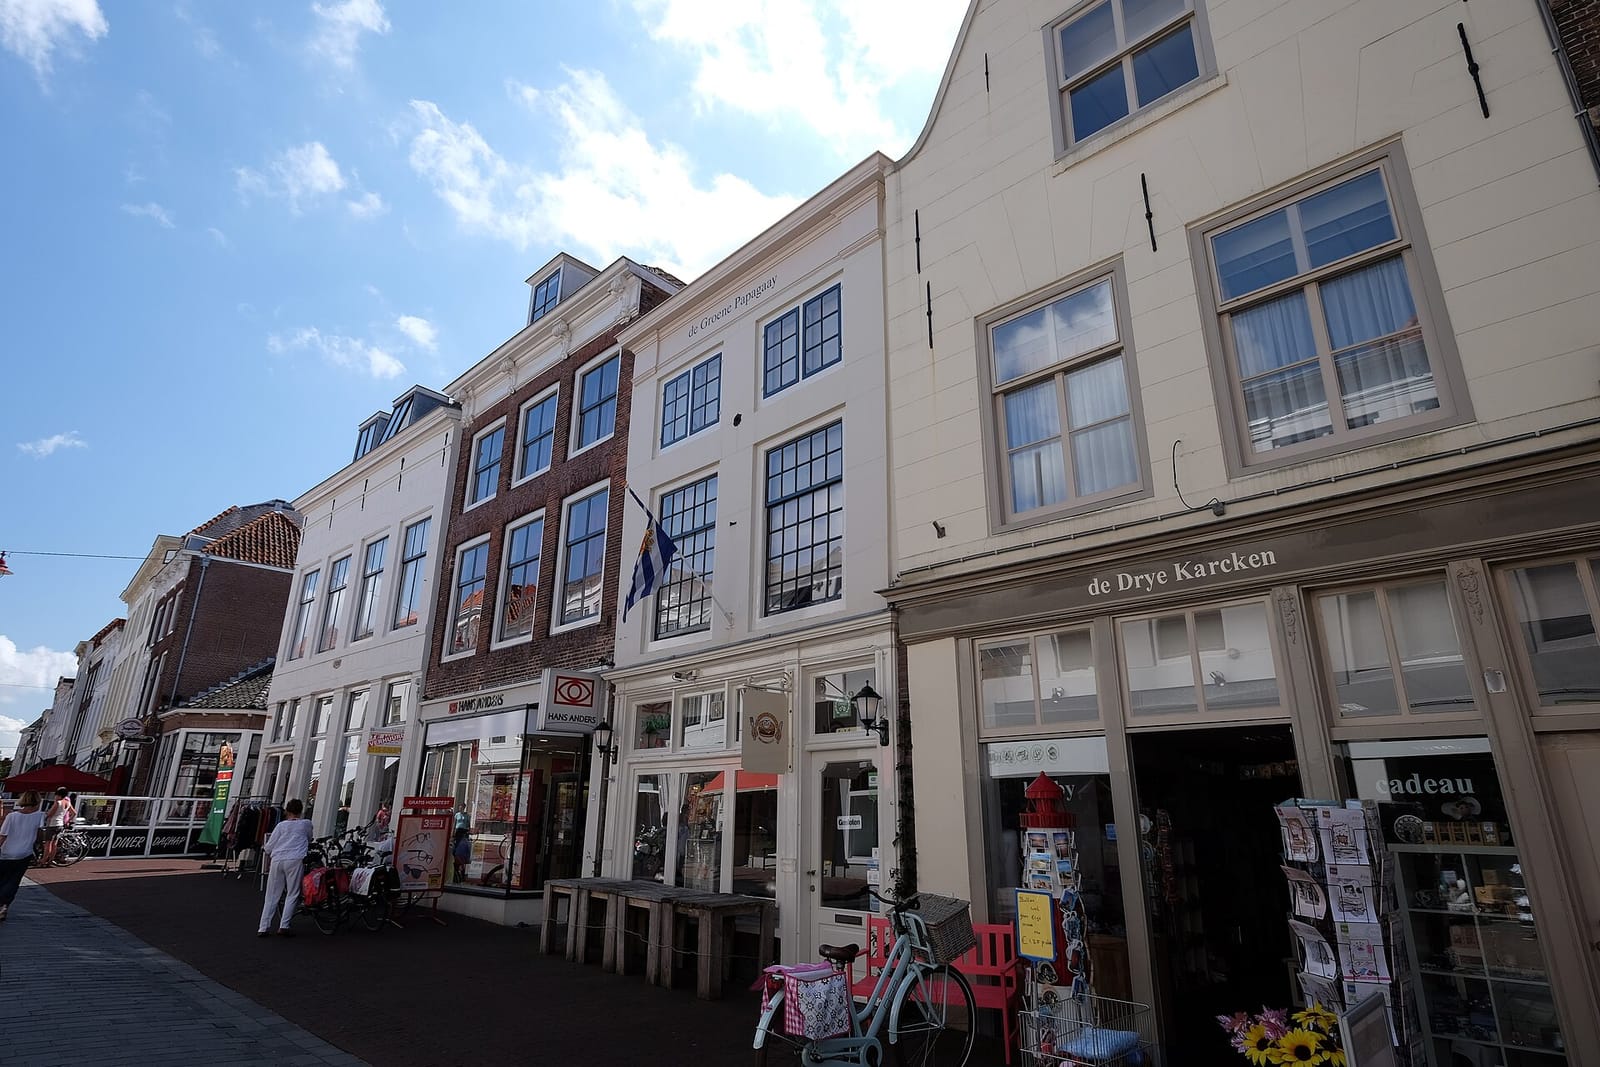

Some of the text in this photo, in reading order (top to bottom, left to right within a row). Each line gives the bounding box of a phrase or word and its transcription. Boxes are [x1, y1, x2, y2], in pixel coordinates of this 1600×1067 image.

[688, 275, 778, 338] de Groene Papagaay
[1087, 549, 1277, 596] de Drye Karcken
[547, 712, 597, 724] HANS ANDERS
[1375, 772, 1476, 795] cadeau
[111, 835, 146, 849] DINER
